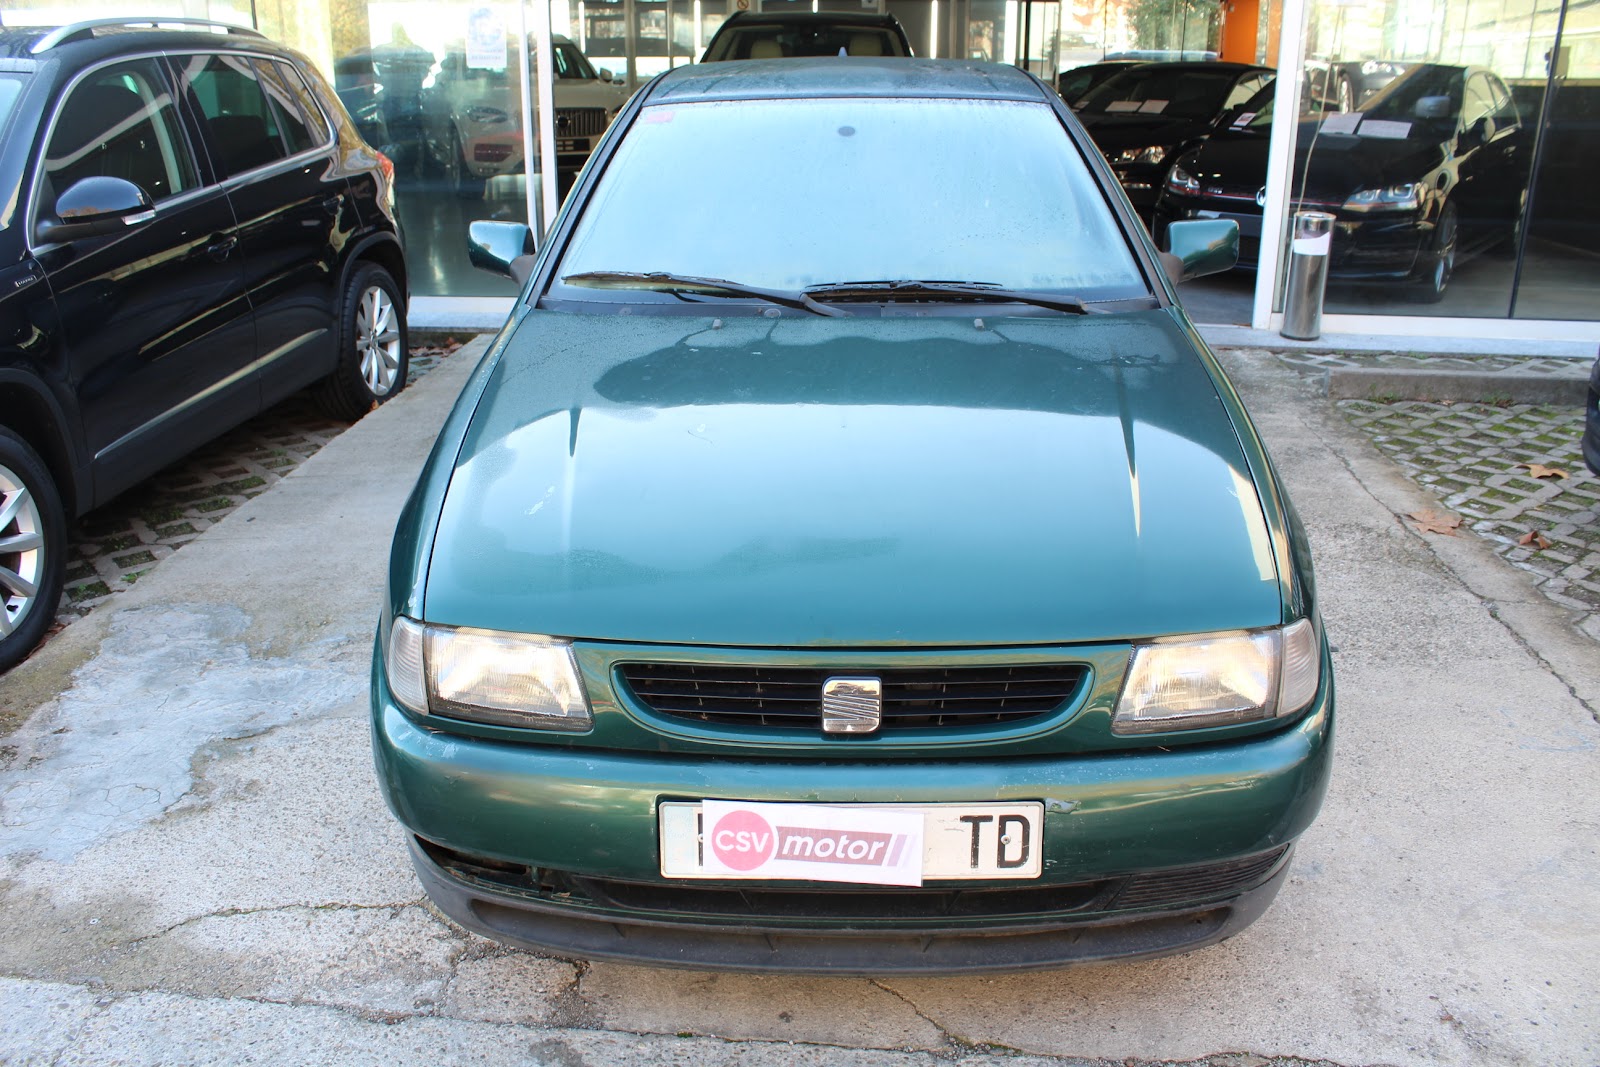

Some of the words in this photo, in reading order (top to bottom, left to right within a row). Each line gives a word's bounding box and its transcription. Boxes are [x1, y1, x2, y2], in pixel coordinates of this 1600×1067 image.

[715, 829, 770, 853] CSV
[782, 834, 885, 860] motor
[960, 814, 1031, 868] TD
